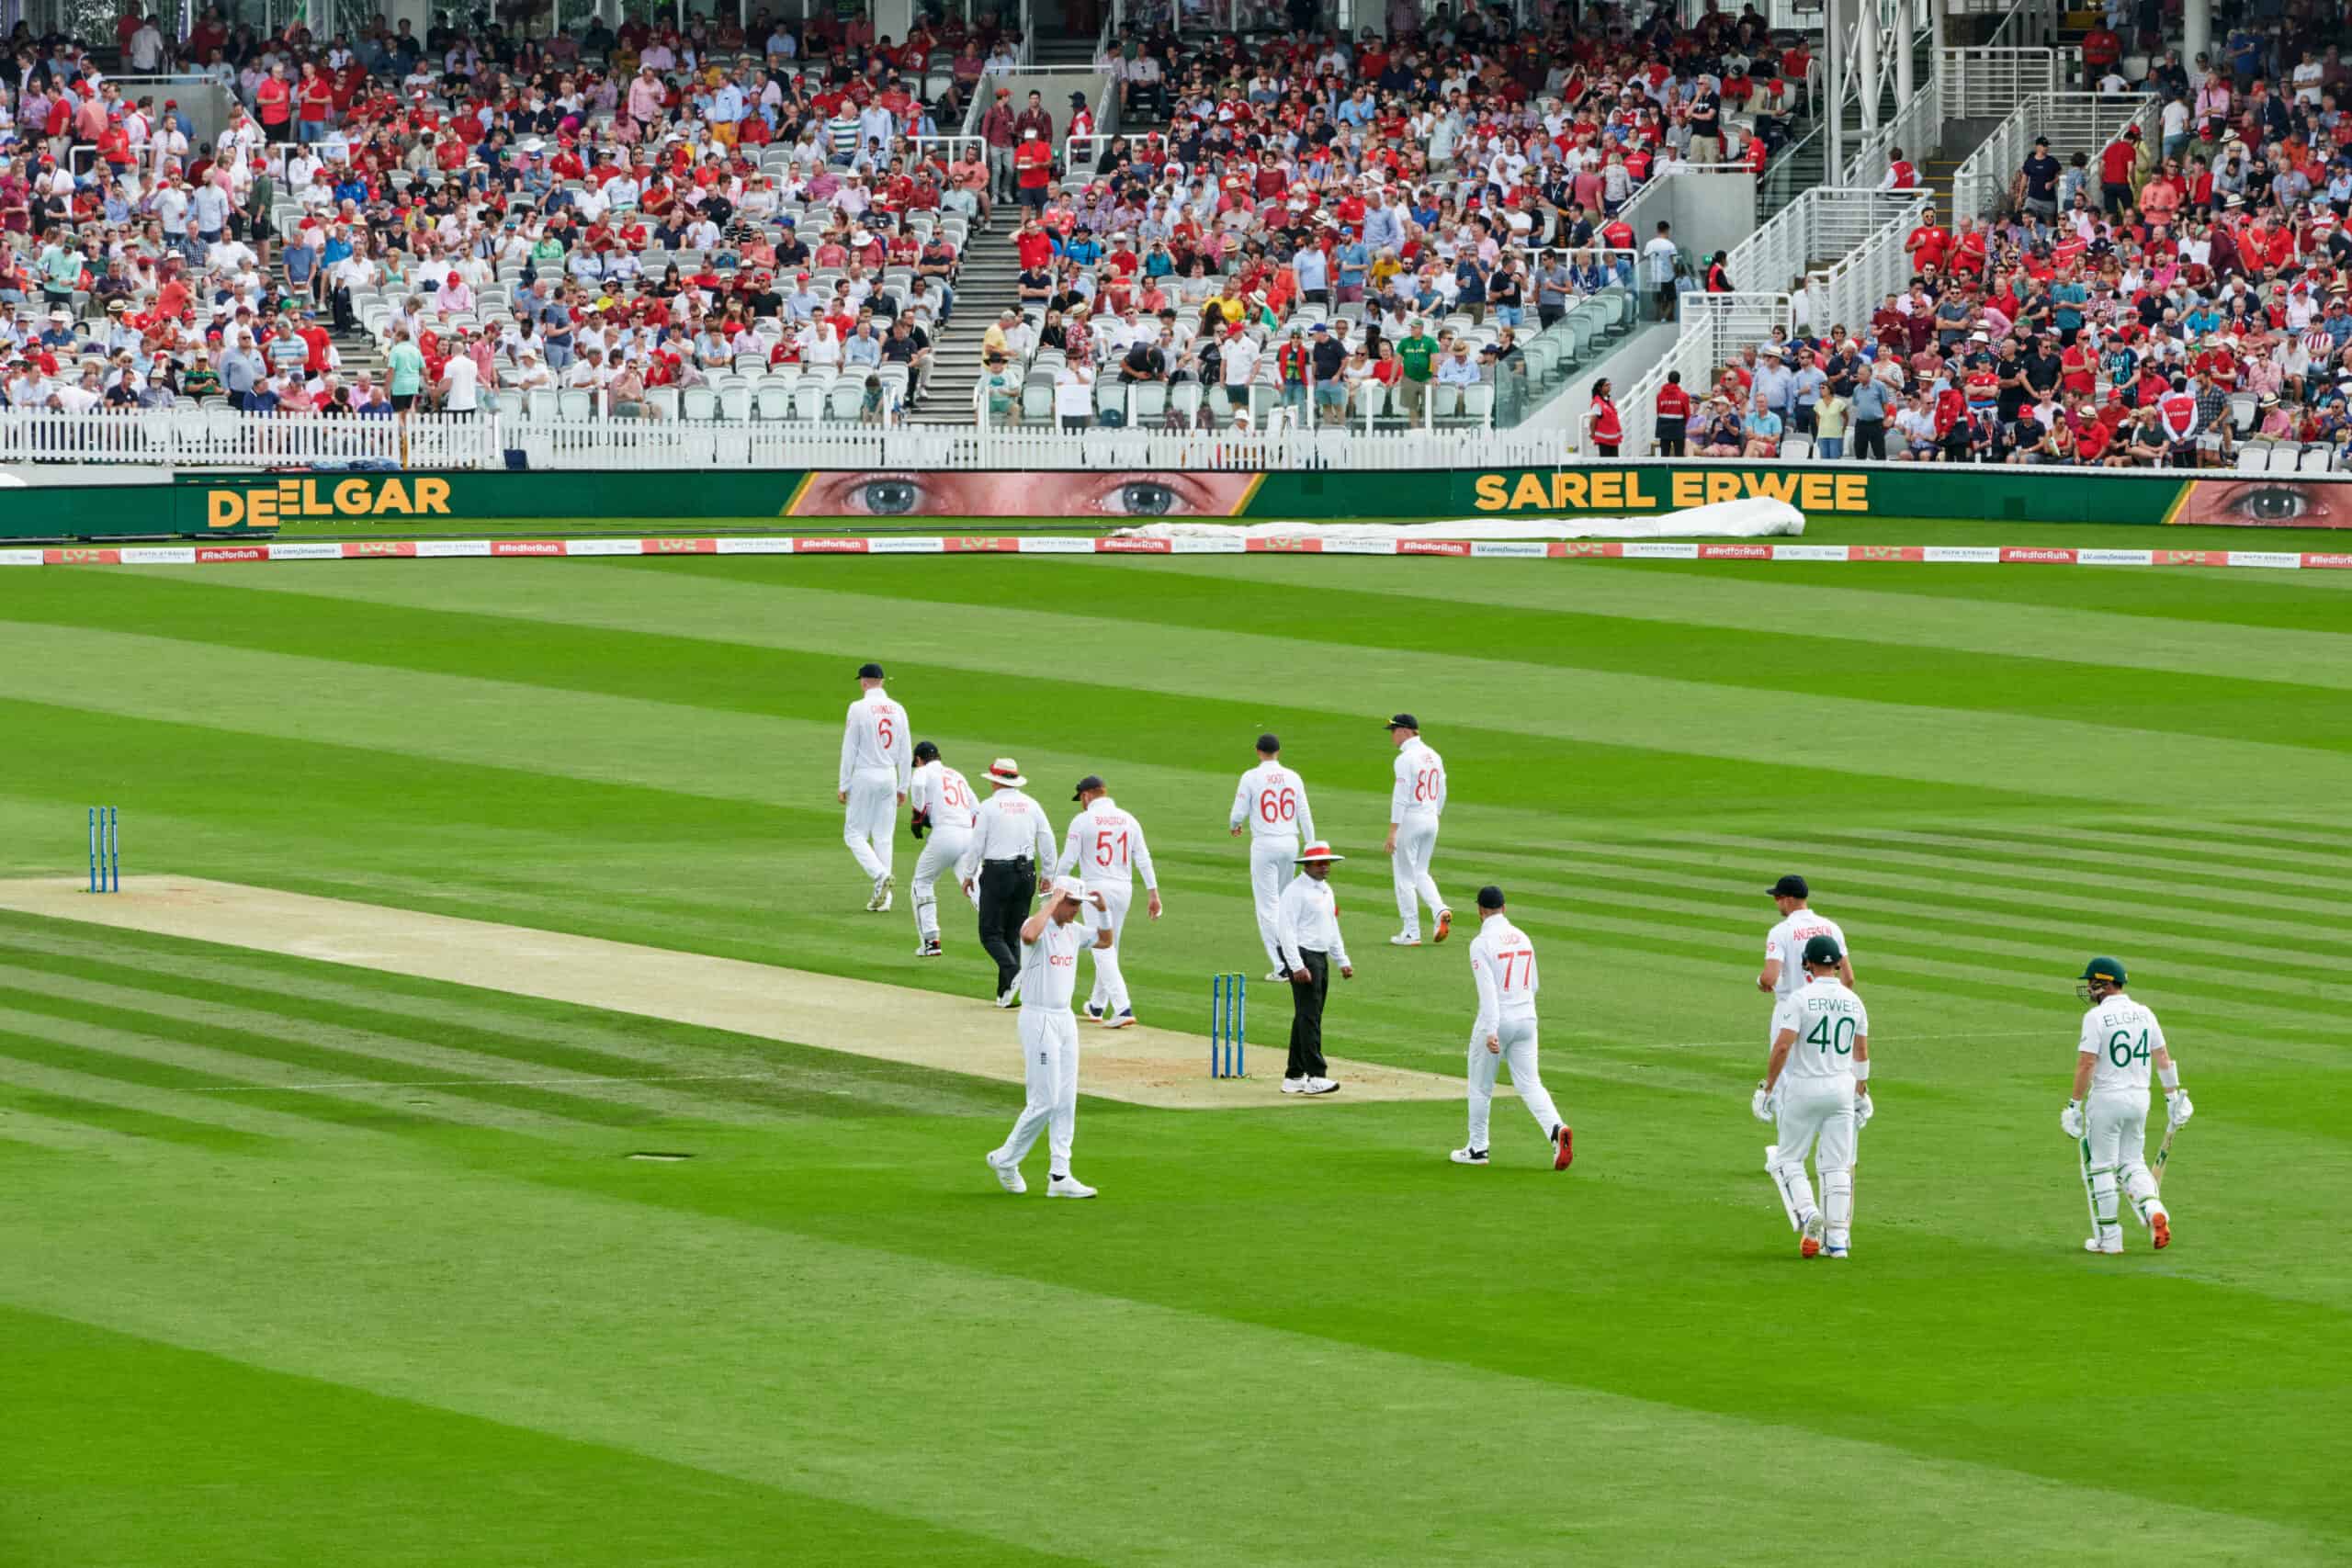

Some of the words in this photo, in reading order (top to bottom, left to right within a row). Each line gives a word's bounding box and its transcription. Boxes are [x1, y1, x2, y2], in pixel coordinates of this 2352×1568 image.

[1474, 473, 1656, 511] SAREL
[1672, 472, 1869, 512] ERWEE
[201, 550, 258, 560] #RedforRuth
[499, 544, 558, 553] #RedforRuth
[801, 539, 861, 549] #RedforRuth
[1104, 539, 1164, 550] #RedforRuth
[1403, 541, 1464, 553] #RedforRuth
[1705, 547, 1765, 557] #RedforRuth
[2008, 550, 2070, 560] #RedforRuth
[877, 717, 893, 750] 6
[942, 775, 969, 809] 50
[1415, 767, 1440, 802] 80
[1260, 787, 1295, 823] 66
[1095, 830, 1129, 867] 51
[1792, 925, 1833, 942] ANDERSON
[1498, 950, 1532, 993] 77
[1806, 998, 1861, 1013] ERWEE
[1806, 1014, 1856, 1055] 40
[2109, 1028, 2151, 1068] 64
